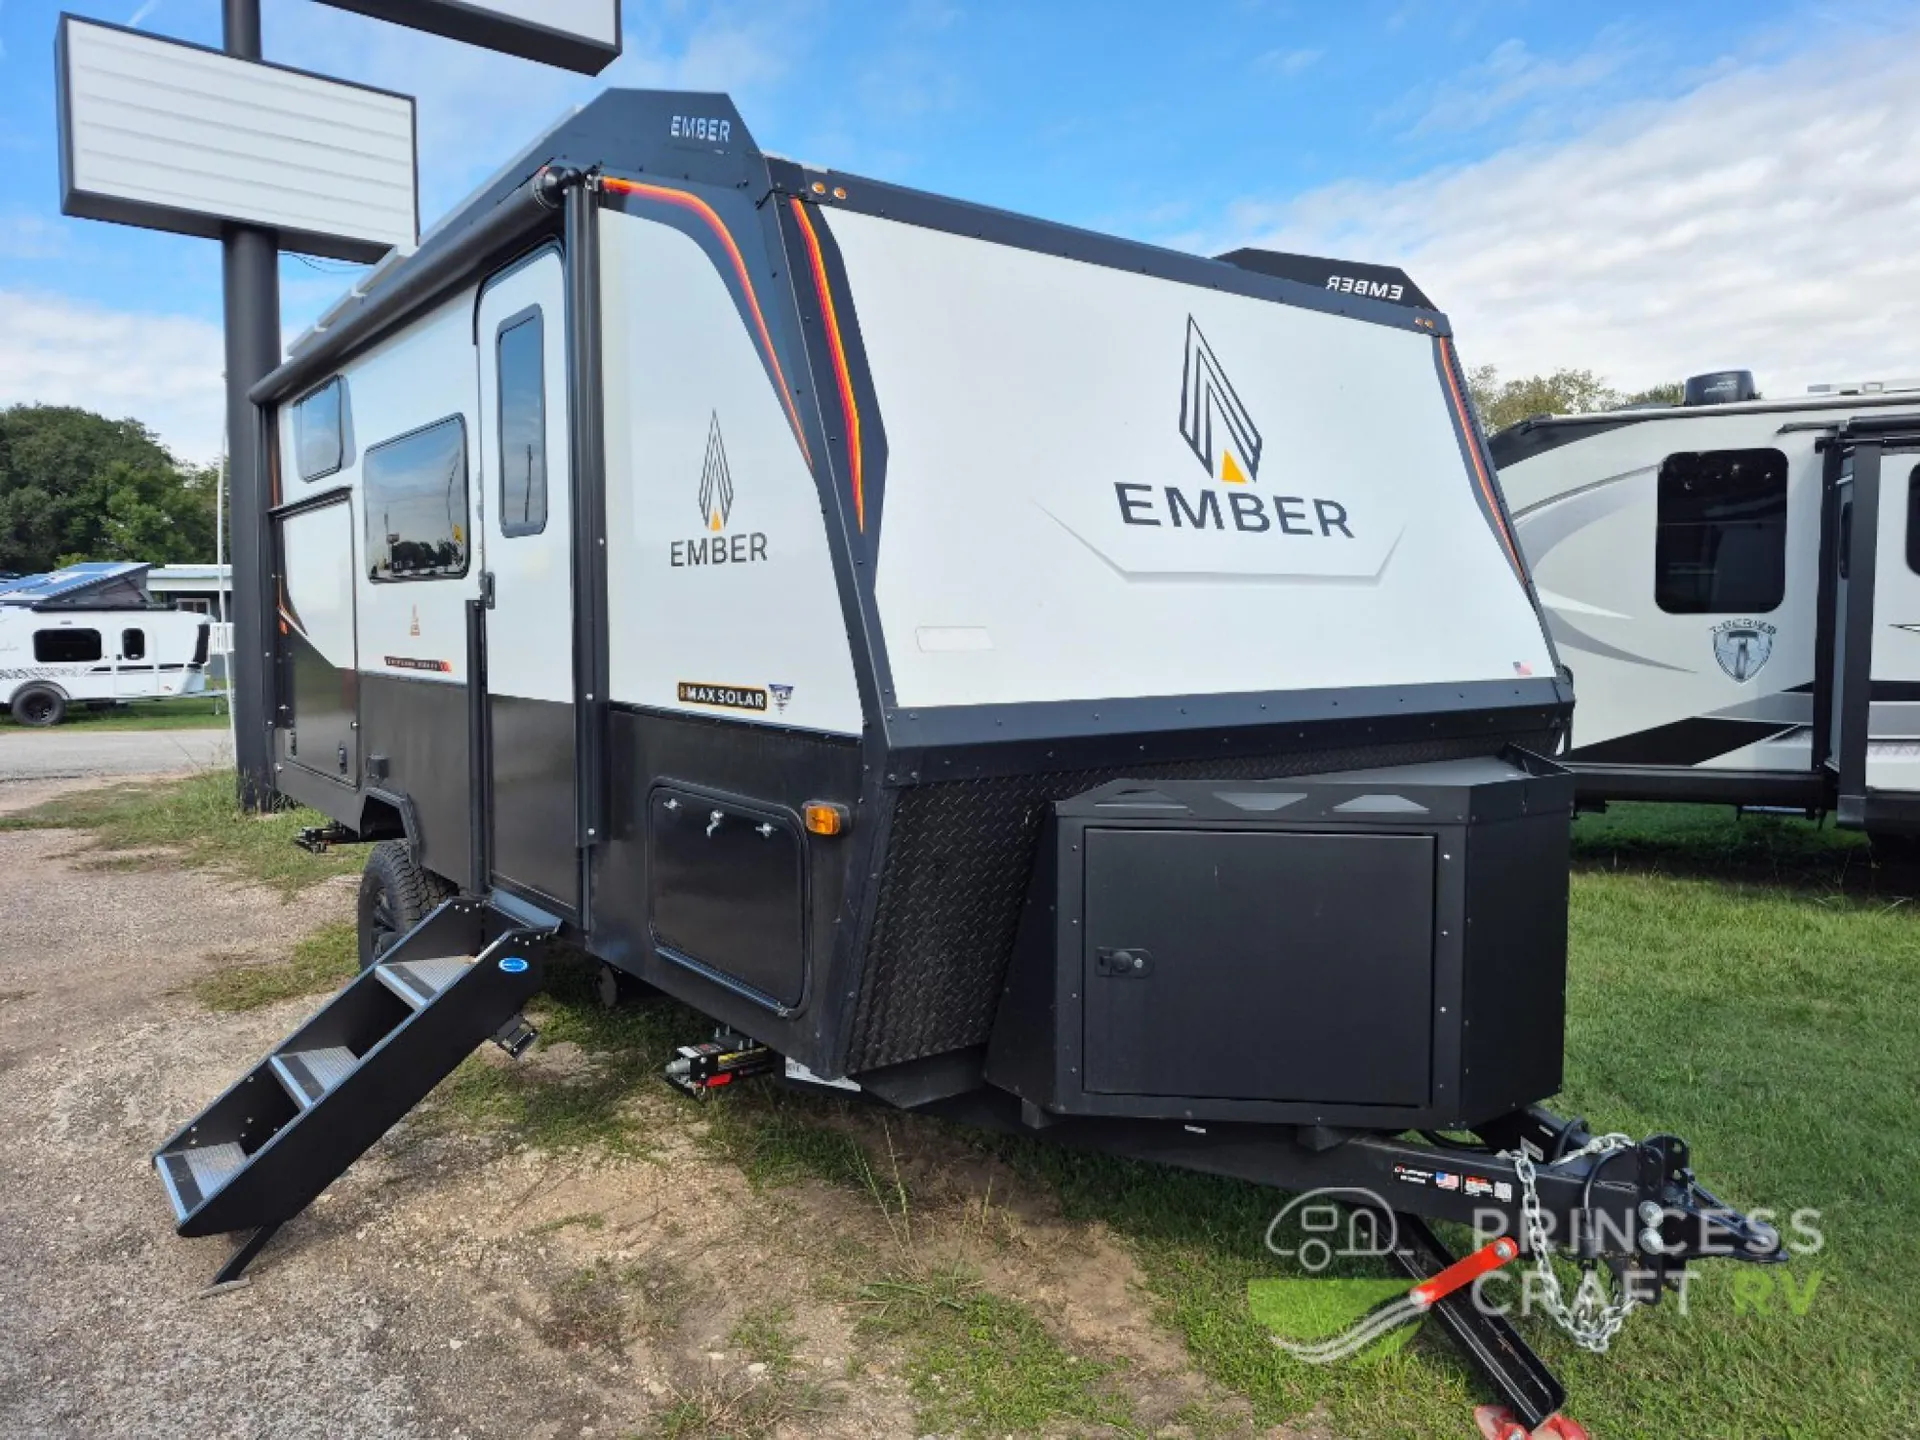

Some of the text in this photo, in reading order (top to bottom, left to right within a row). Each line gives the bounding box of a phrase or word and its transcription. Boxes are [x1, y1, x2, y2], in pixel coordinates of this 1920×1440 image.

[670, 115, 731, 143] EMBER
[1113, 481, 1356, 539] EMBER
[670, 531, 768, 567] EMBER
